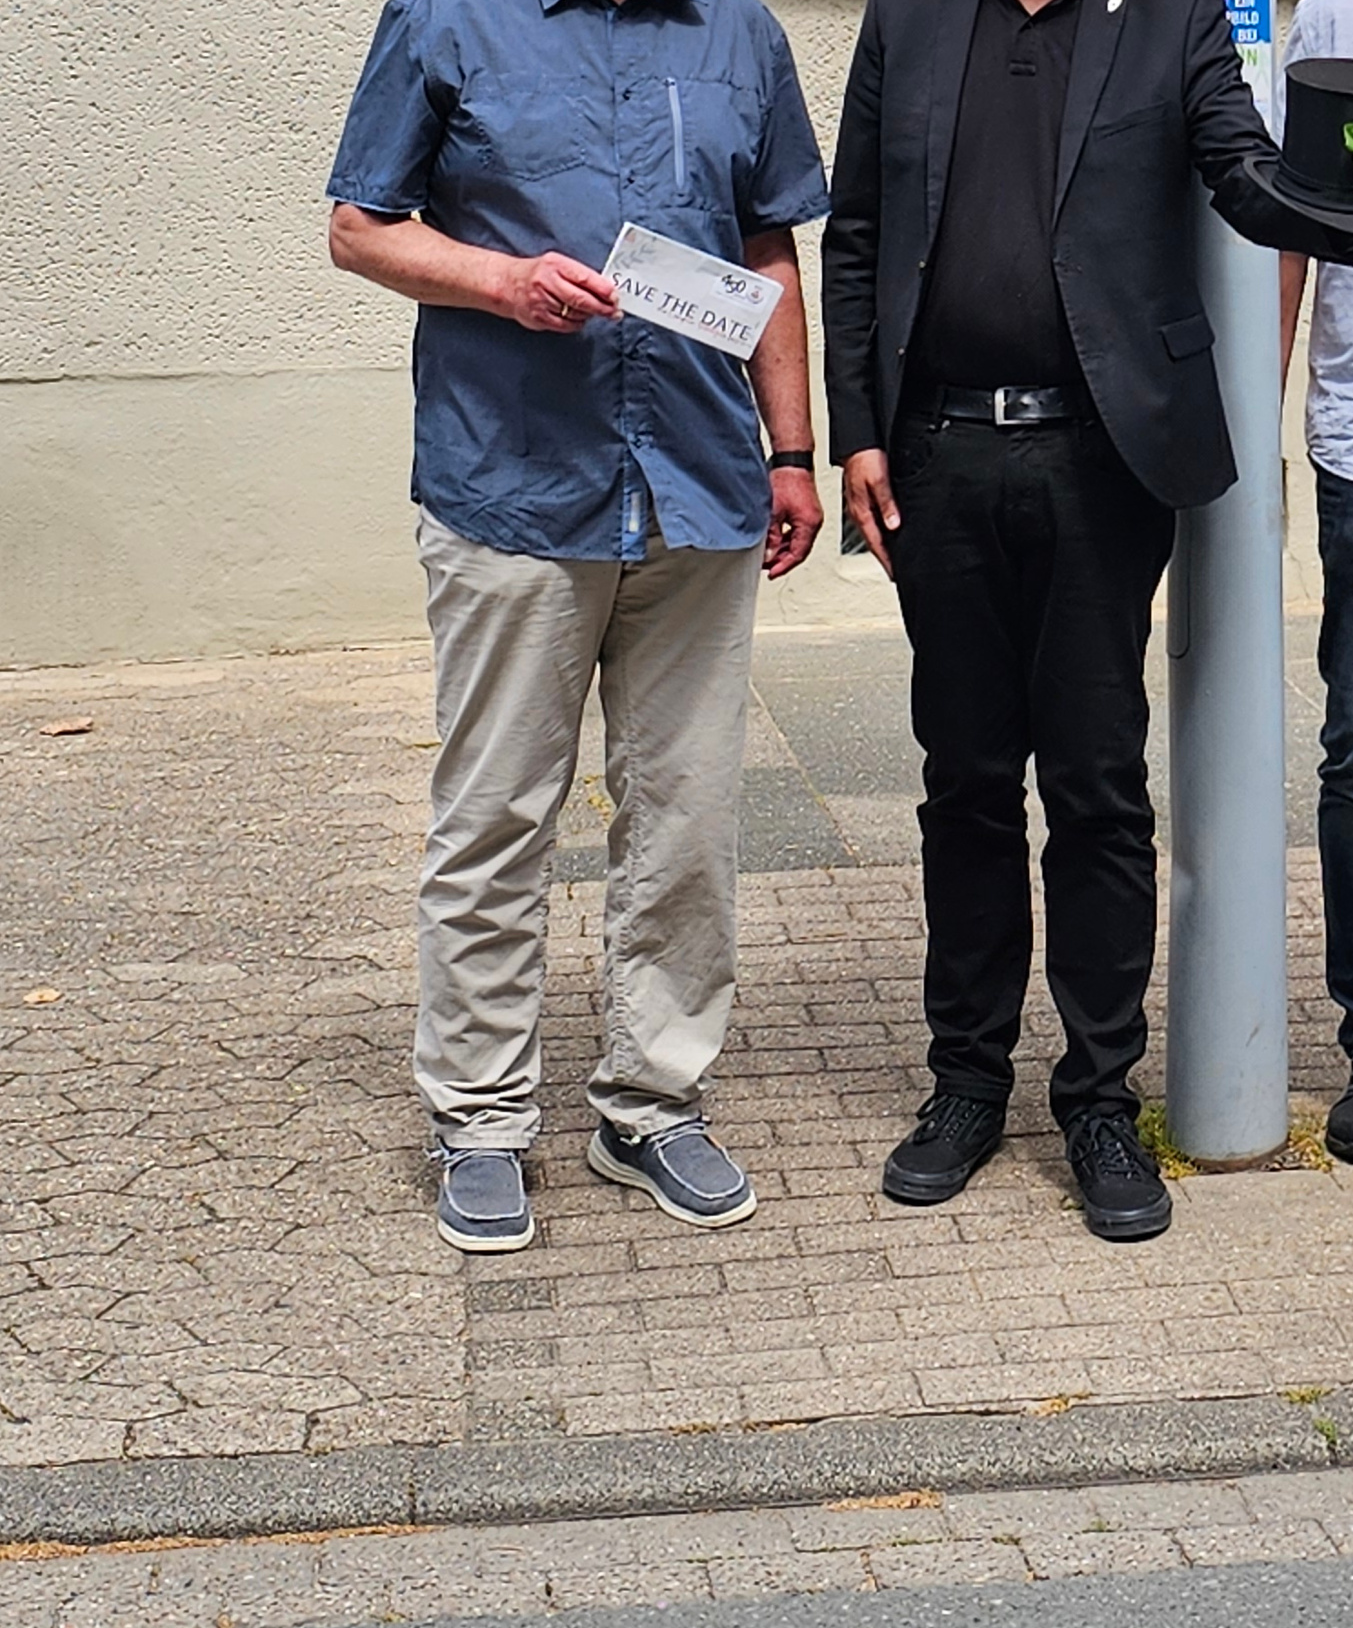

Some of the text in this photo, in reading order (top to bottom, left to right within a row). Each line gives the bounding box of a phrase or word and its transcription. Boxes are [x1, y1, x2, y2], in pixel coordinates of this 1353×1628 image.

[612, 272, 659, 303] SAVE
[661, 292, 699, 320] THE
[701, 310, 753, 341] DATE
